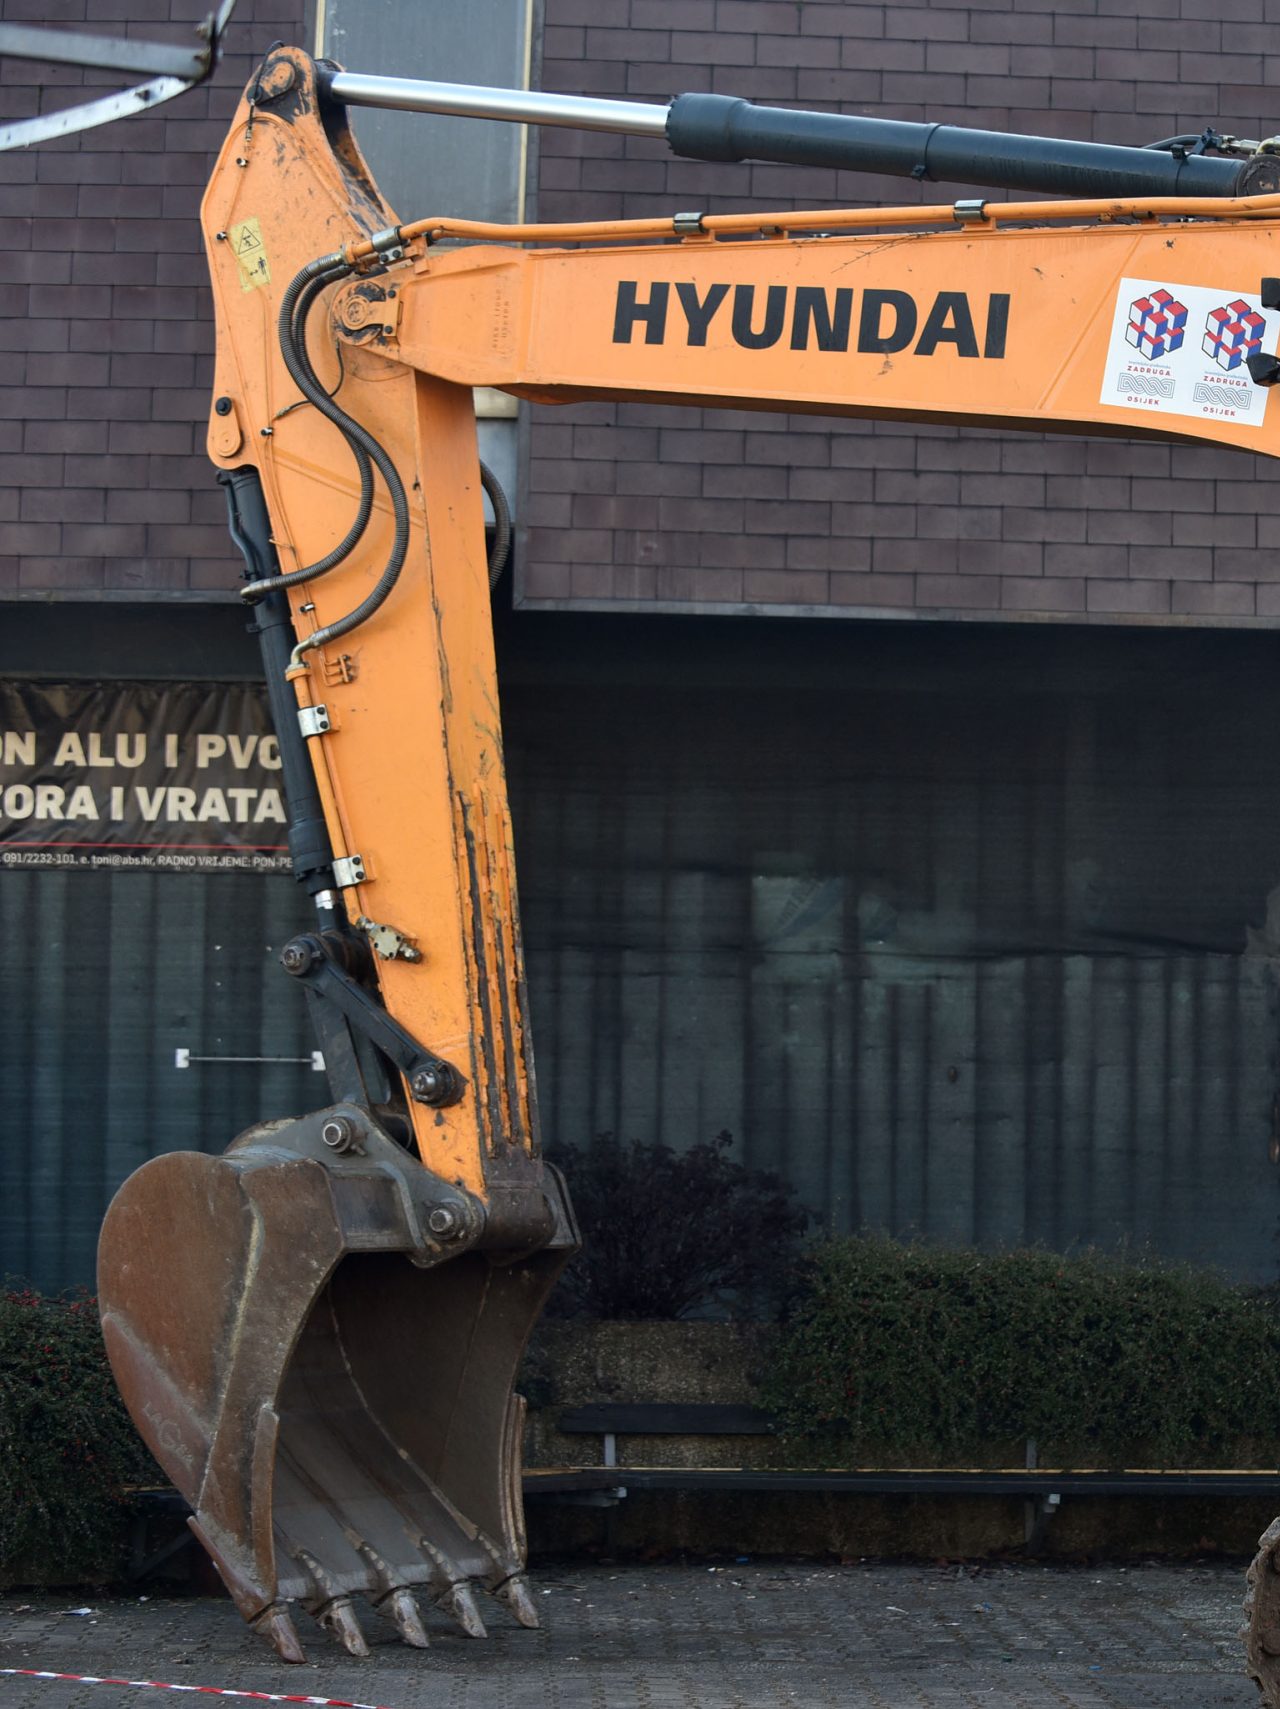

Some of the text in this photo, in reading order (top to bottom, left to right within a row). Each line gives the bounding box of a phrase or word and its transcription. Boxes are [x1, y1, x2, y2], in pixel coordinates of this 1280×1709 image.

[612, 280, 1011, 359] HYUNDAI
[1127, 365, 1171, 376] ZADRUGA
[1203, 375, 1248, 388] ZADRUGA
[1127, 396, 1160, 406] OSIJEK
[1203, 406, 1236, 417] OSIJEK
[0, 731, 283, 770] N ALU I PVC
[0, 784, 287, 823] ORA I VRATA
[158, 855, 196, 866] RADNO
[253, 857, 294, 868] PON-PE
